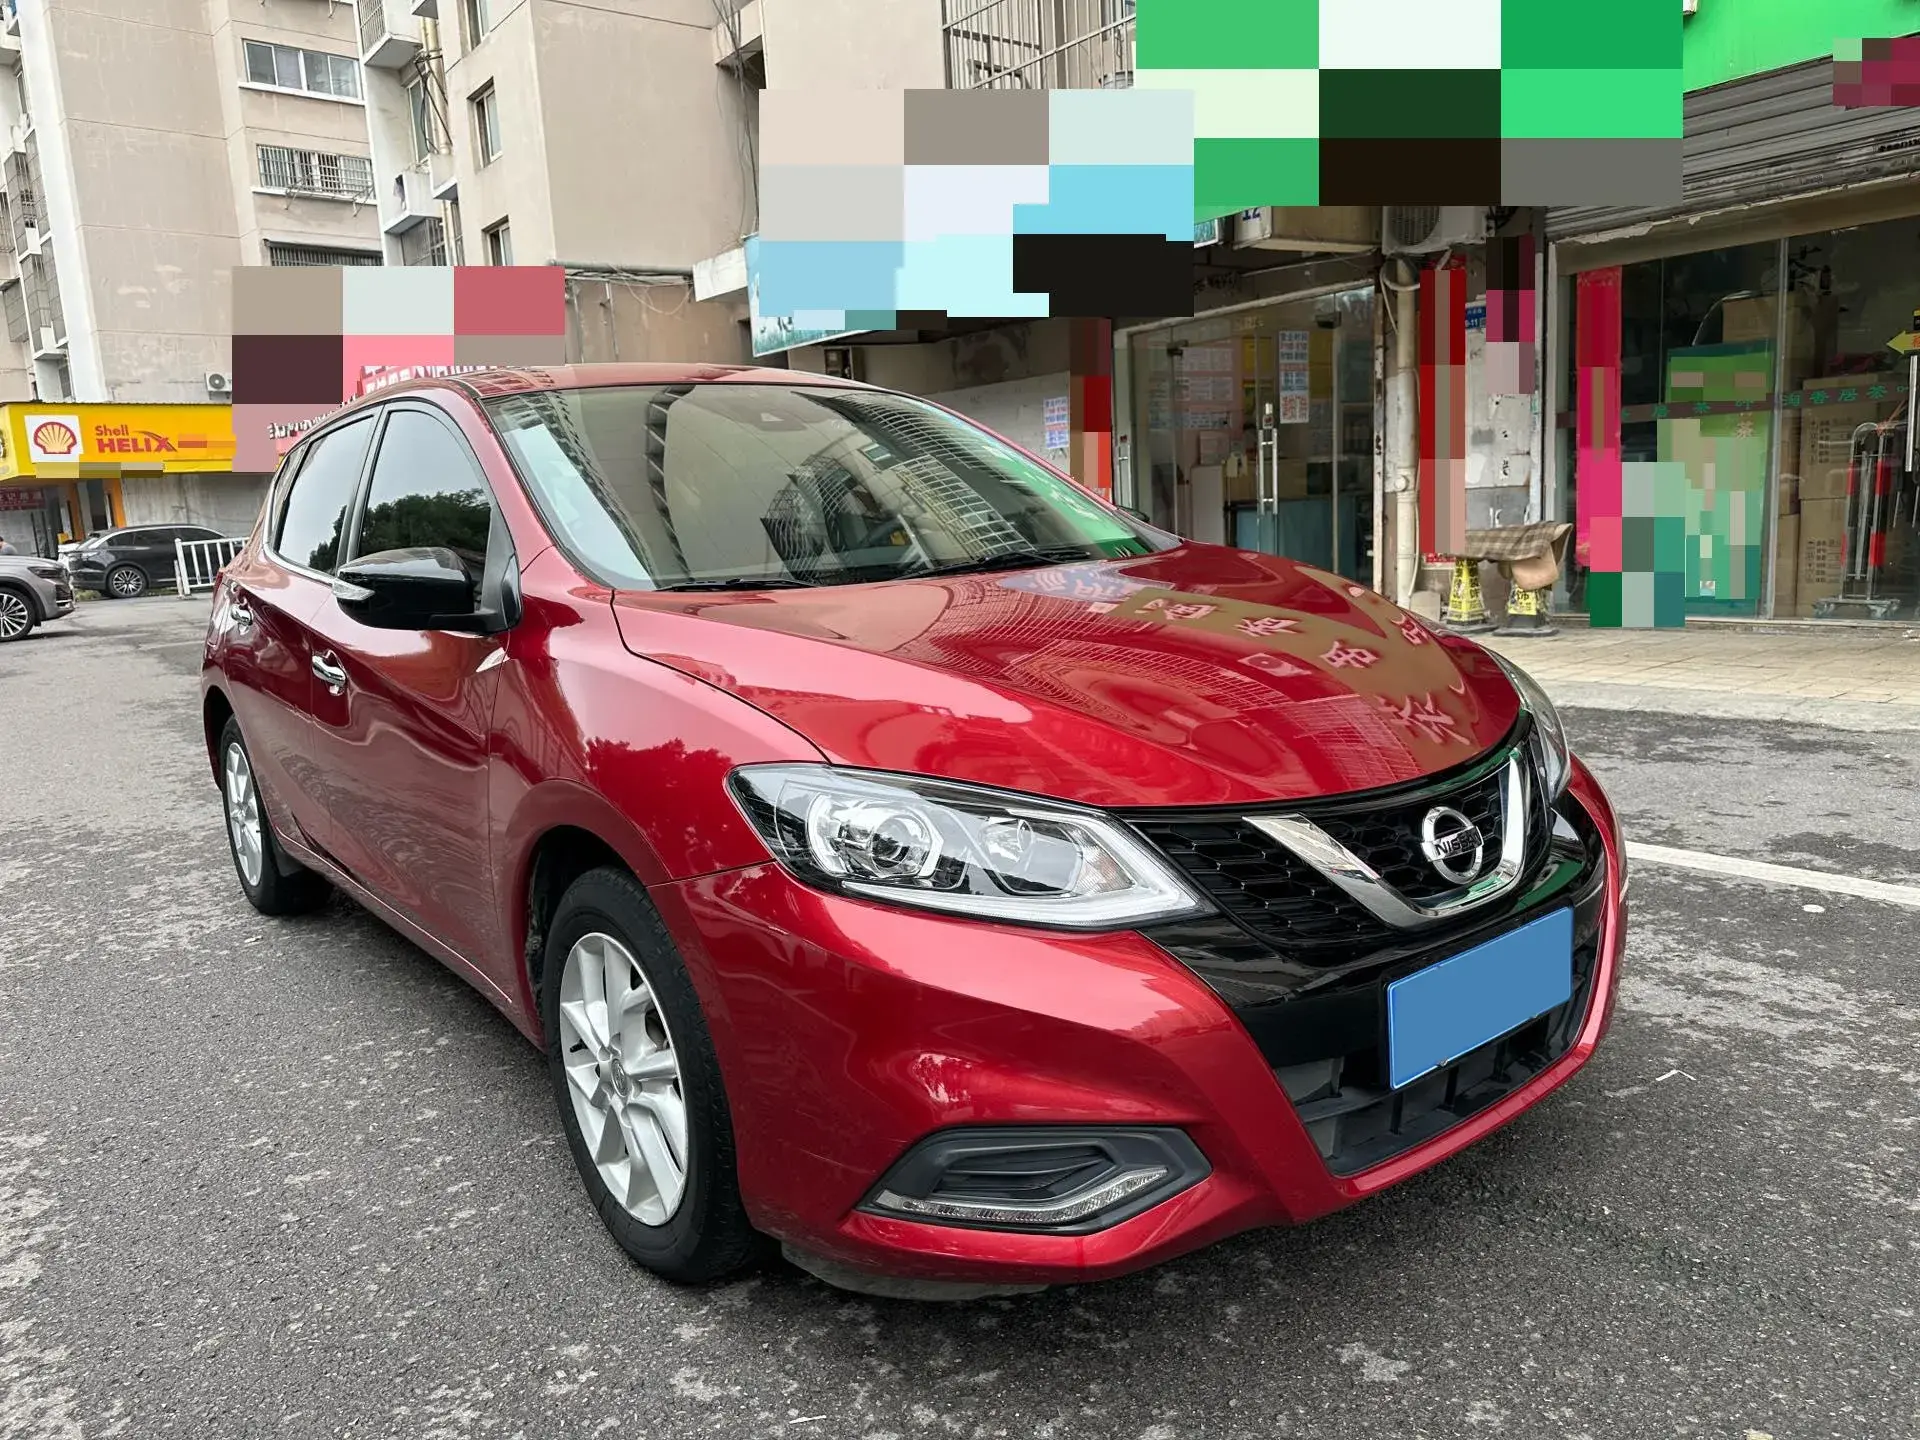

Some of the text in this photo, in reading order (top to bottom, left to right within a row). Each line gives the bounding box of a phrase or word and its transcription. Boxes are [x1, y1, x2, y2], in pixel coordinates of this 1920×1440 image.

[94, 424, 129, 437] Shell
[96, 437, 175, 454] HELIX
[1434, 832, 1481, 857] NISSAN
